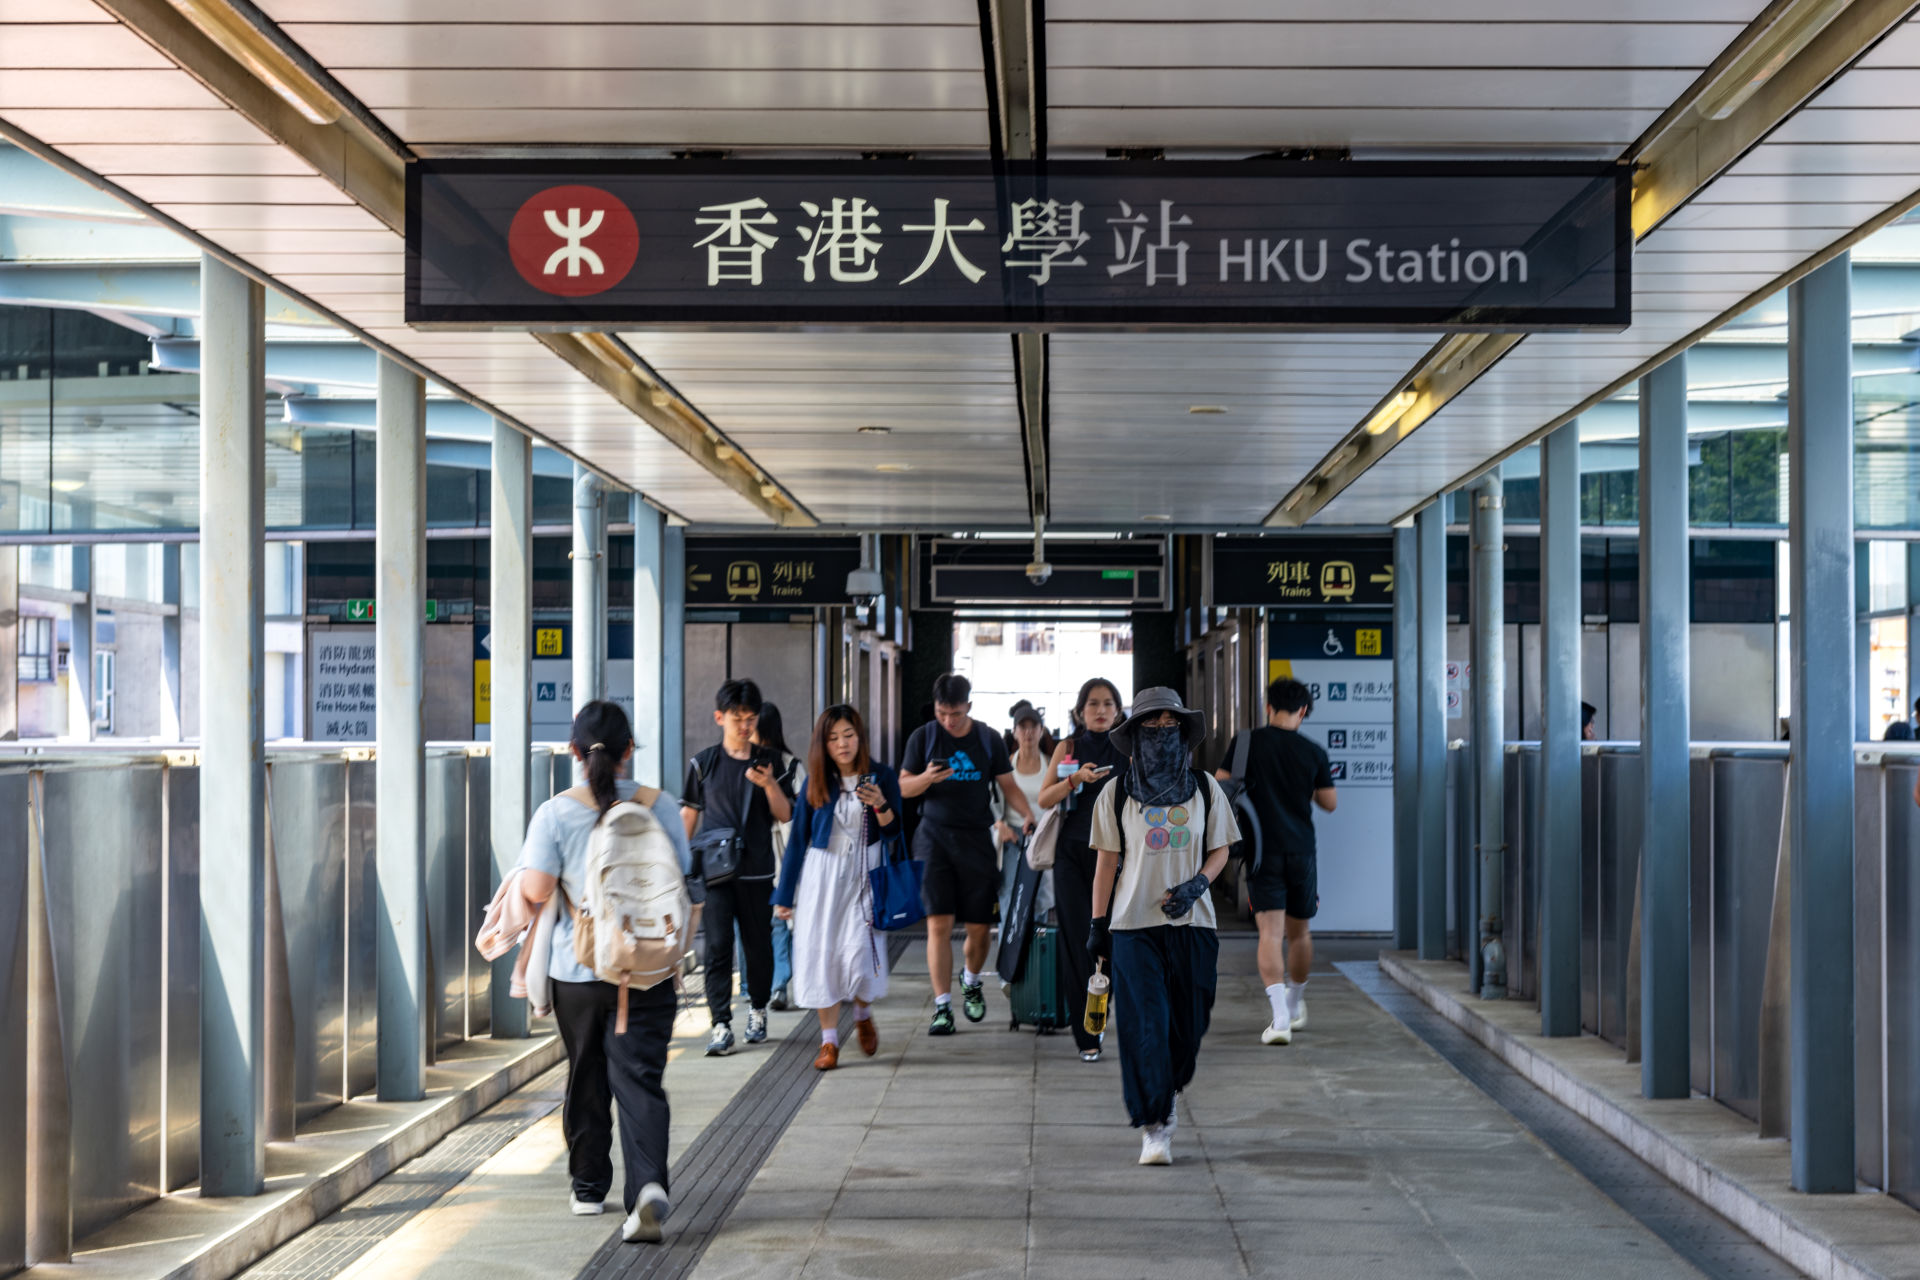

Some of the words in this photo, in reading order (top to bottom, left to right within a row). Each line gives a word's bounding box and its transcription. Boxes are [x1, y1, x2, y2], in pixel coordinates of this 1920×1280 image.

[693, 197, 1193, 287] 香港大學站
[1219, 238, 1328, 283] HKU
[1345, 237, 1529, 284] Station
[773, 561, 815, 583] 列車
[1267, 560, 1311, 584] 列車
[771, 585, 802, 596] Trains
[1280, 585, 1312, 597] Trains
[320, 663, 337, 674] Fire
[339, 663, 376, 677] Hydrant
[316, 701, 333, 712] Fire
[335, 701, 358, 712] Hose
[360, 701, 376, 712] Ree
